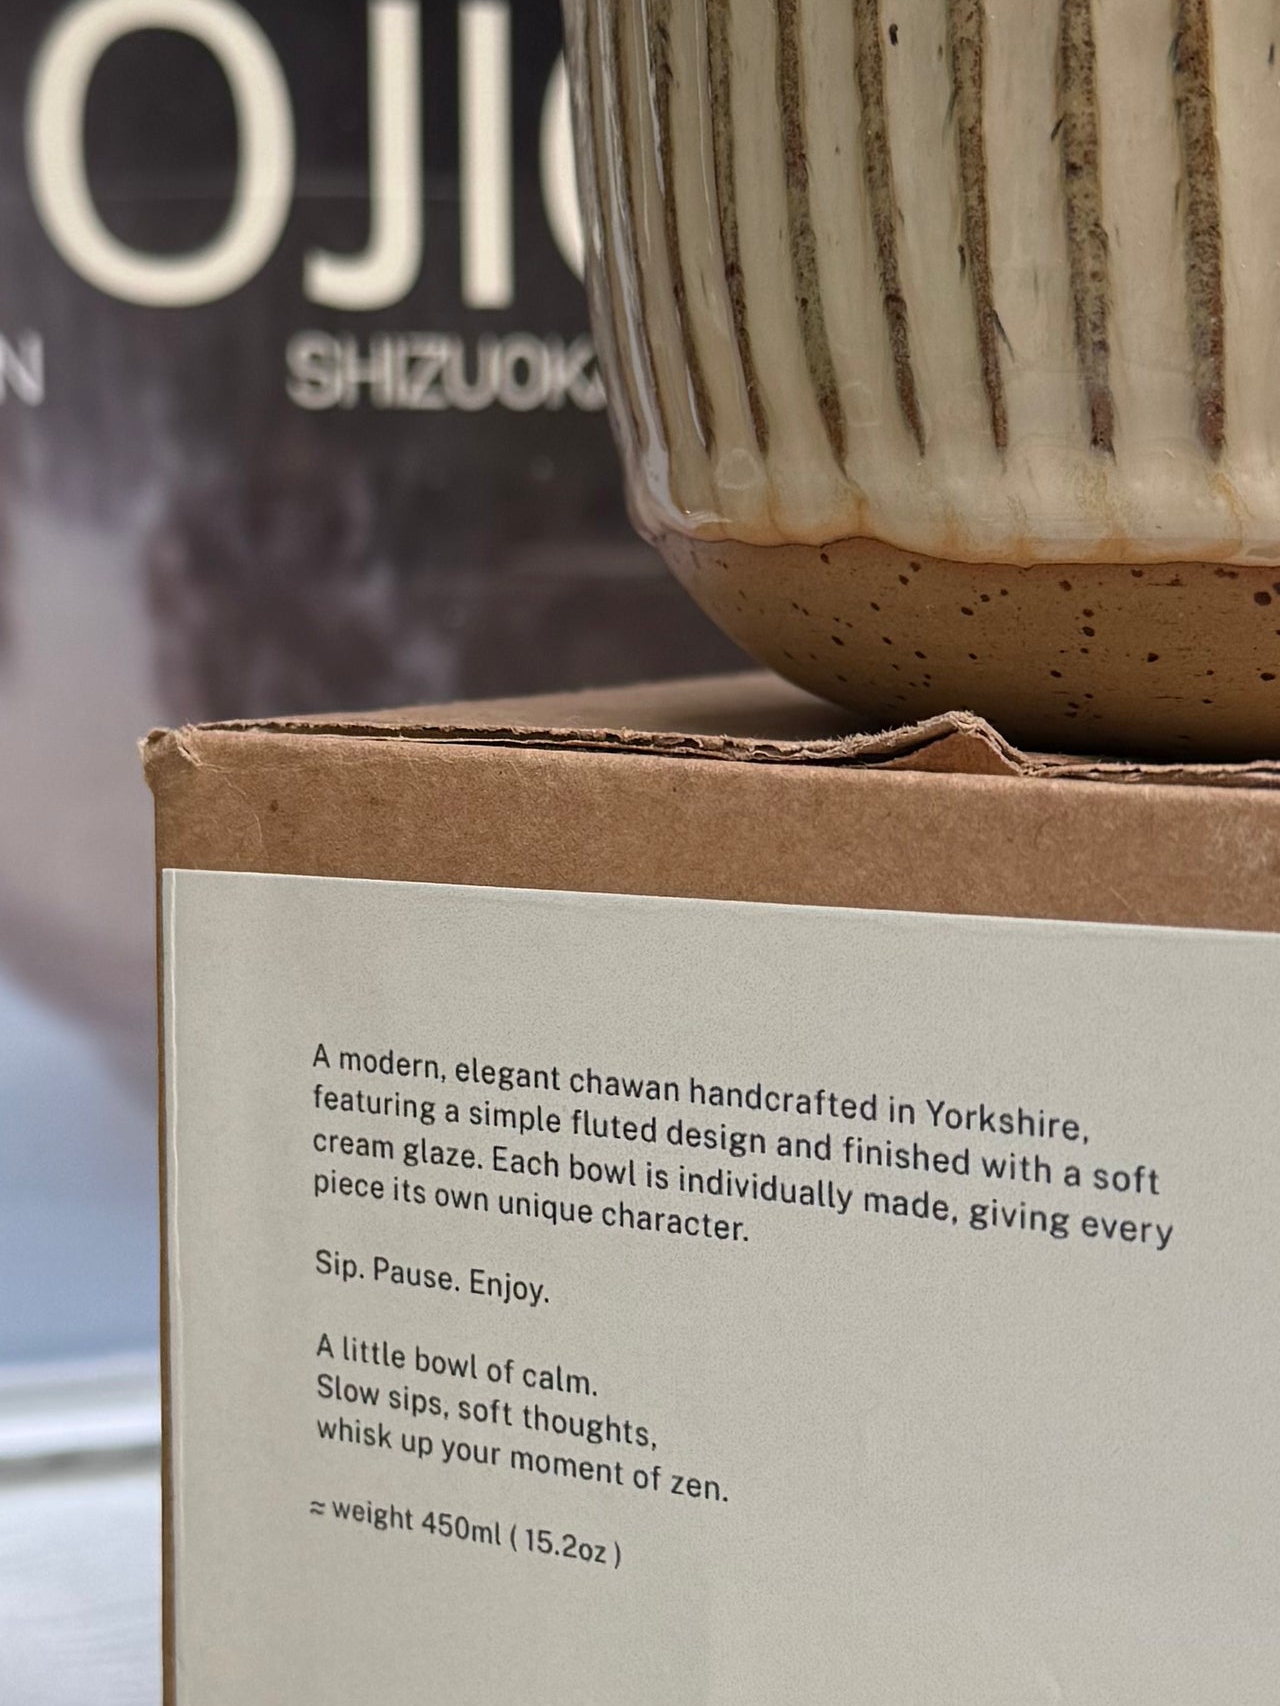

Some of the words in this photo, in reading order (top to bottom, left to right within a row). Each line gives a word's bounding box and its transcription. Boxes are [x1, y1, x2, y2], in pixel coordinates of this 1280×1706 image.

[285, 331, 608, 412] SHIZUOK
[312, 1042, 331, 1069] A
[339, 1048, 447, 1084] modern,
[454, 1056, 561, 1093] elegant
[569, 1067, 681, 1103] chawan
[689, 1076, 878, 1122] handcrafted
[888, 1095, 916, 1126] in
[925, 1098, 1089, 1146] Yorkshire,
[312, 1083, 437, 1127] featuring
[443, 1102, 460, 1125] a
[468, 1096, 562, 1137] simple
[569, 1108, 658, 1152] fluted
[665, 1118, 767, 1159] design
[775, 1132, 832, 1162] and
[841, 1135, 970, 1176] finished
[980, 1151, 1052, 1185] with
[1063, 1164, 1081, 1188] a
[1092, 1164, 1160, 1196] soft
[312, 1132, 395, 1161] cream
[402, 1136, 484, 1170] glaze.
[491, 1144, 560, 1179] Each
[569, 1152, 638, 1187] bowl
[646, 1160, 670, 1191] is
[678, 1164, 854, 1216] individually
[863, 1189, 958, 1226] made,
[968, 1197, 1071, 1240] giving
[1080, 1215, 1174, 1252] every
[313, 1168, 385, 1201] piece
[393, 1175, 427, 1206] its
[434, 1186, 489, 1213] own
[497, 1191, 594, 1226] unique
[601, 1199, 749, 1242] character.
[315, 1248, 365, 1283] Sip.
[373, 1255, 460, 1293] Pause.
[469, 1267, 550, 1308] Enjoy.
[315, 1332, 336, 1360] A
[342, 1334, 406, 1370] little
[415, 1344, 479, 1380] bowl
[486, 1358, 515, 1385] of
[522, 1364, 598, 1397] calm.
[316, 1372, 381, 1407] Slow
[388, 1384, 450, 1421] sips,
[457, 1398, 513, 1427] soft
[522, 1403, 657, 1452] thoughts,
[316, 1415, 393, 1450] whisk
[401, 1432, 434, 1460] up
[440, 1438, 502, 1466] your
[510, 1449, 625, 1486] moment
[632, 1464, 663, 1492] of
[670, 1474, 729, 1503] zen.
[331, 1500, 414, 1532] weight
[420, 1510, 502, 1547] 450ml
